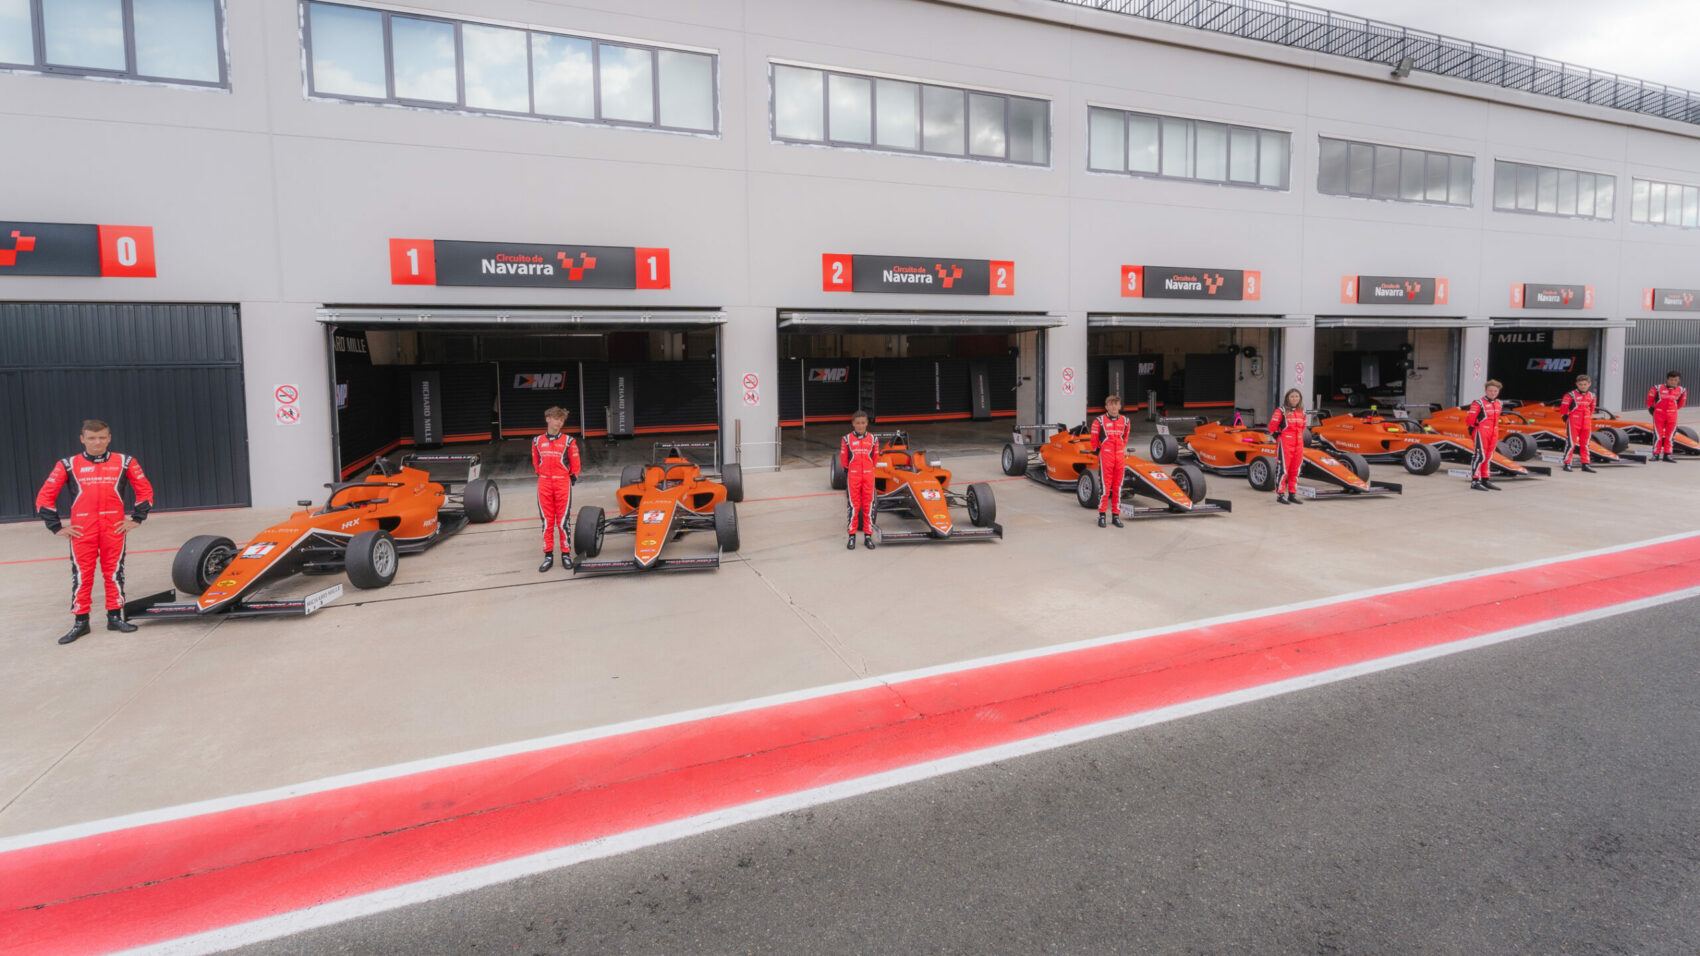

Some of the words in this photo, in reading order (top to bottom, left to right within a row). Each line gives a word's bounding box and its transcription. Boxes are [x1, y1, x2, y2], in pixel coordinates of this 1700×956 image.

[116, 236, 138, 267] 0
[496, 253, 531, 263] Circuito
[532, 254, 544, 263] de
[405, 248, 420, 276] 1
[481, 258, 554, 275] Navarra
[647, 256, 658, 281] 1
[831, 261, 844, 284] 2
[882, 269, 933, 284] Navarra
[996, 267, 1007, 289] 2
[1127, 271, 1137, 291] 3
[1165, 278, 1202, 291] Navarra
[1247, 276, 1256, 295] 3
[1345, 281, 1354, 298] 4
[1375, 286, 1404, 297] Navarra
[1437, 283, 1445, 299] 4
[1498, 331, 1546, 344] MILLE
[422, 381, 431, 417] RICHARD
[424, 418, 433, 443] MILLE
[341, 518, 360, 530] HRX
[647, 513, 659, 521] 2
